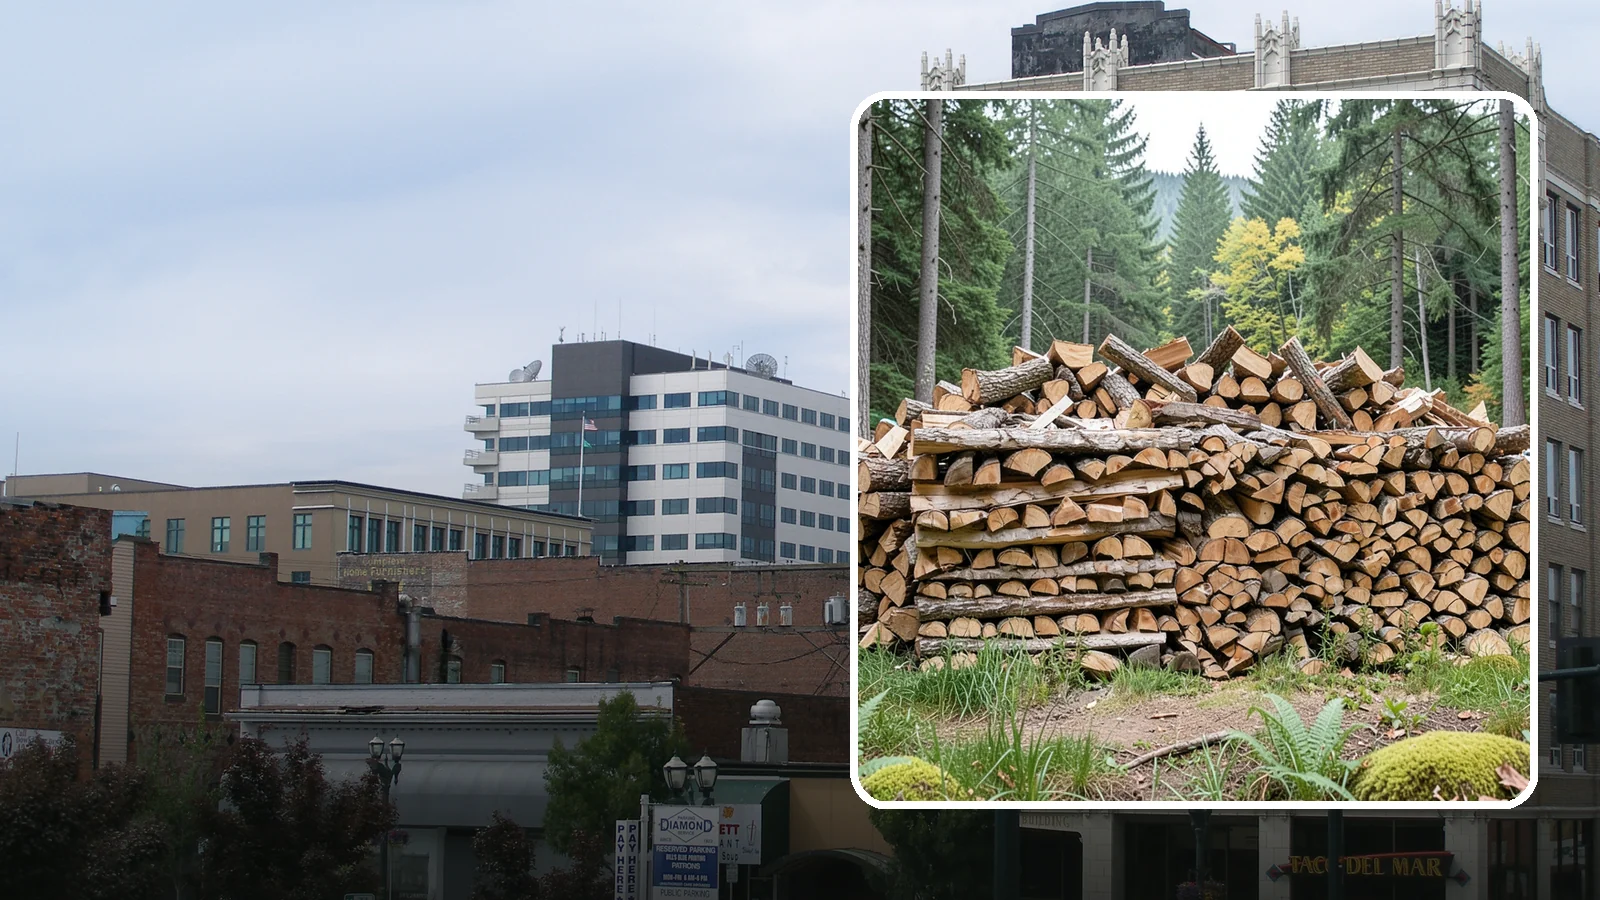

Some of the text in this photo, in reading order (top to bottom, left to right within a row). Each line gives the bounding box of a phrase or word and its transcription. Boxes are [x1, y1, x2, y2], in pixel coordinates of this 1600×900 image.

[362, 557, 406, 567] Complete
[343, 566, 427, 577] Home Furnishers
[660, 818, 713, 832] DIAMOND
[1022, 815, 1070, 828] BUILDING
[656, 845, 688, 853] RESERVED
[616, 825, 625, 893] PAY HERE
[627, 824, 637, 893] PAY HERE
[721, 851, 739, 861] Soup
[671, 862, 701, 870] PATRONS
[1289, 855, 1443, 877] TAC DEL MAR
[660, 888, 710, 898] PUBLIC PARKING
